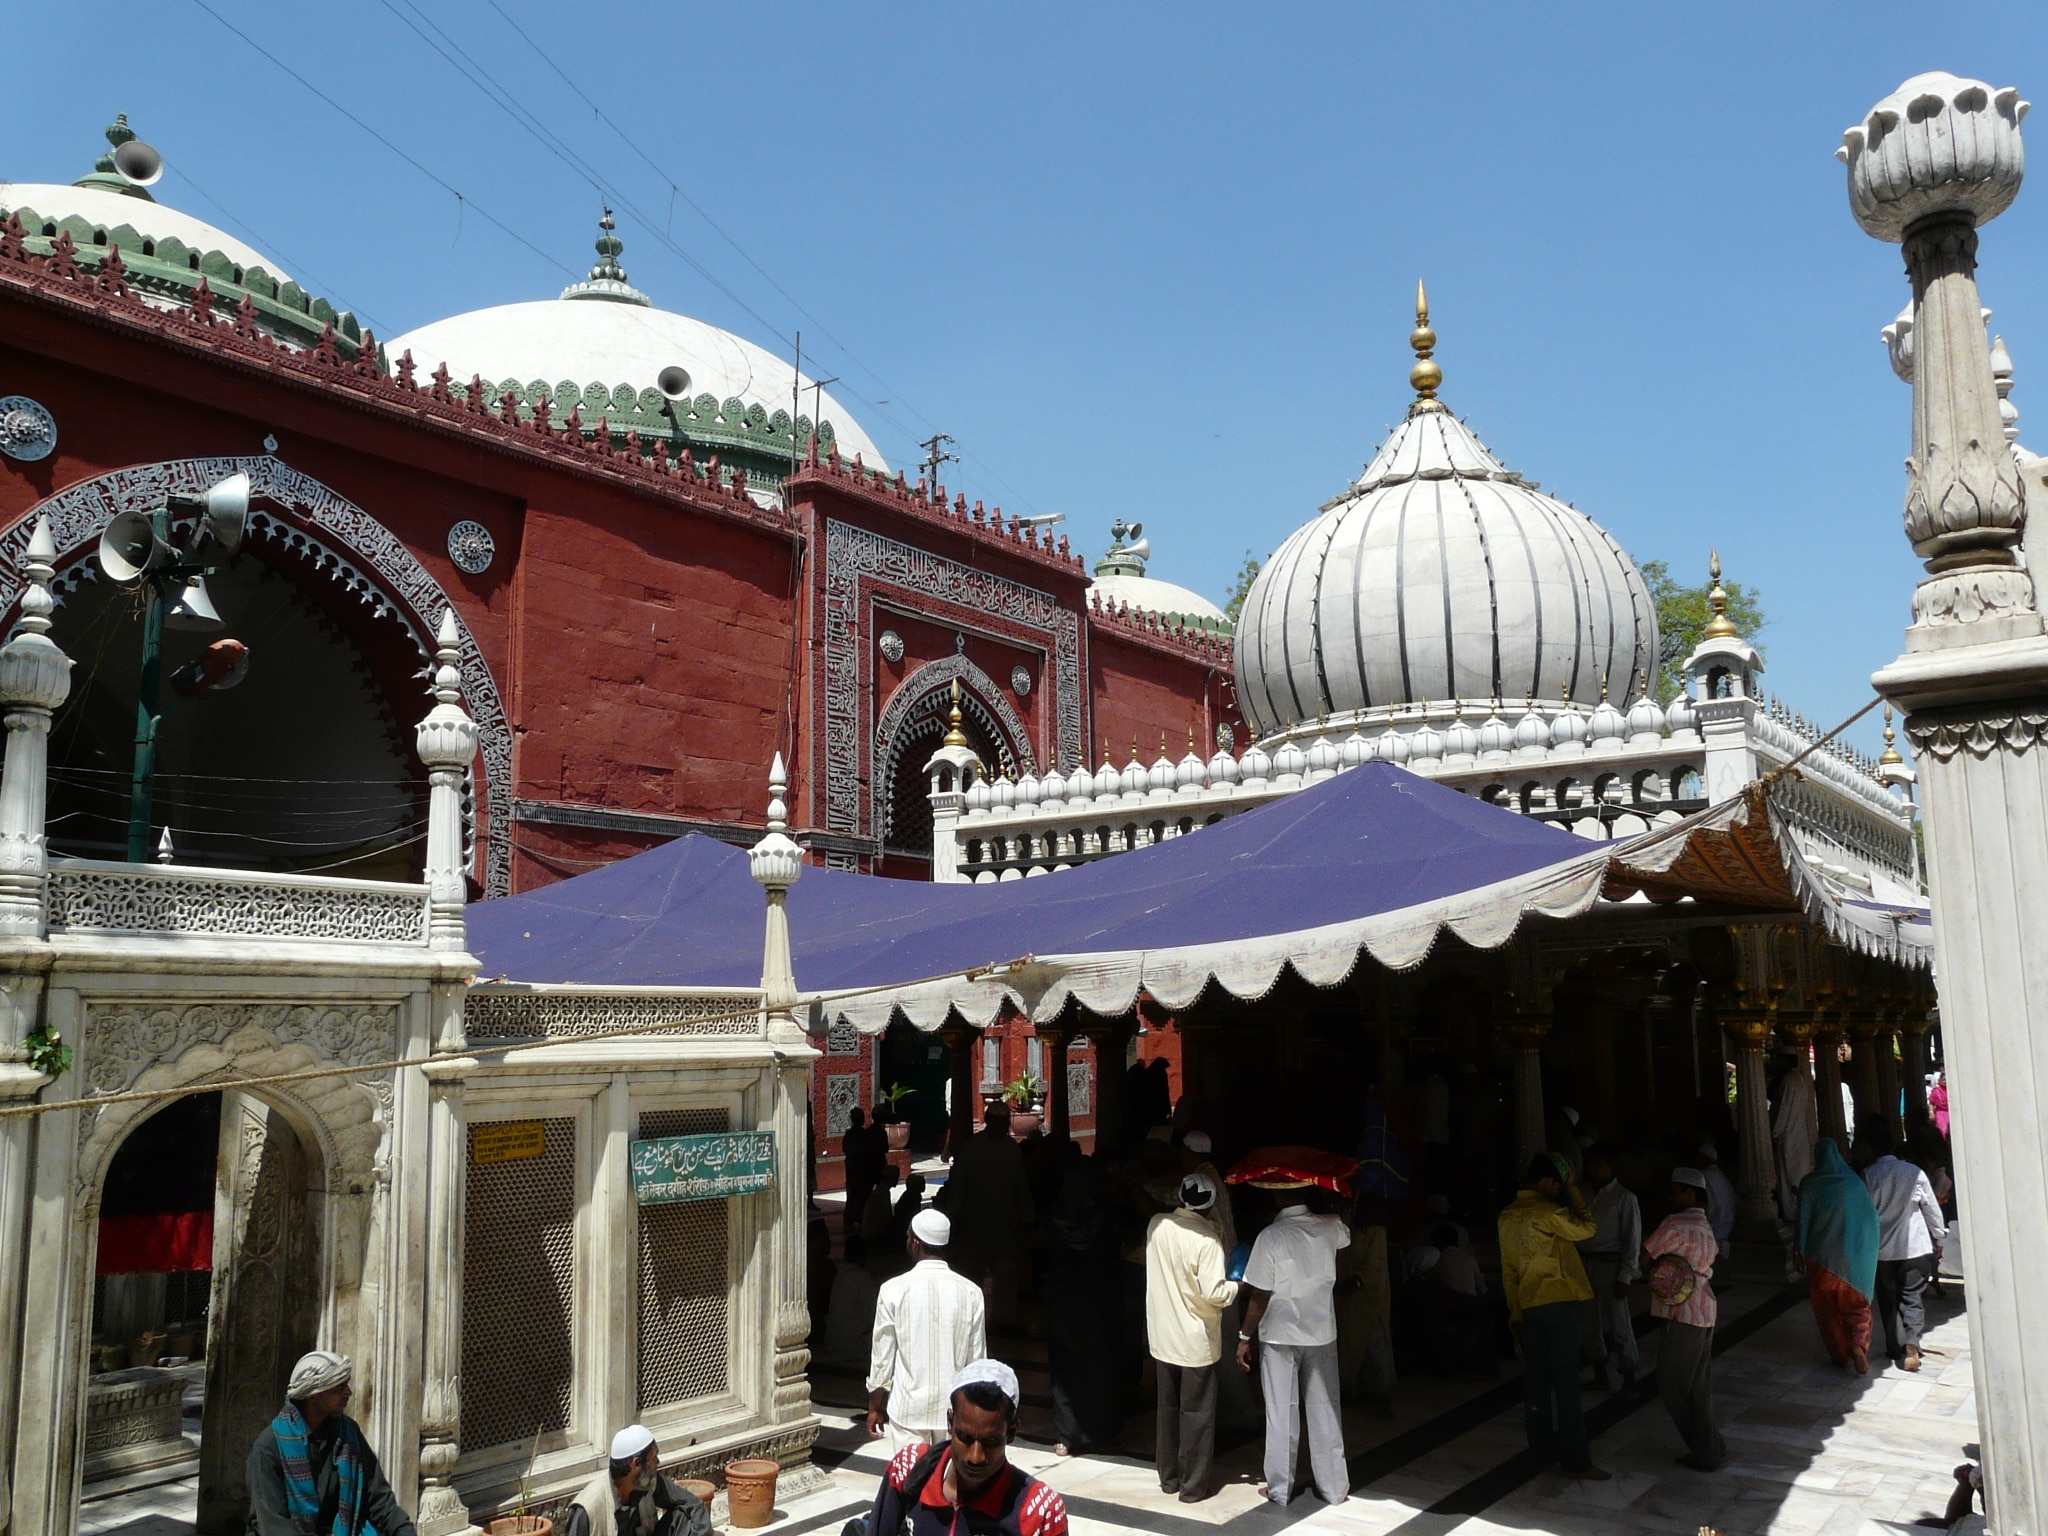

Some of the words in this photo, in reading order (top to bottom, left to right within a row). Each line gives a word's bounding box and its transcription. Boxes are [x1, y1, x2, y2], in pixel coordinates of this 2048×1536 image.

[635, 1151, 653, 1175] ہے
[643, 1146, 658, 1175] منع
[657, 1141, 681, 1168] گھومنا
[673, 1145, 697, 1175] میں
[687, 1142, 709, 1171] صحن
[704, 1138, 737, 1171] شریف
[707, 1139, 720, 1160] کے
[649, 1180, 668, 1198] लेकर
[736, 1175, 754, 1191] घूमना
[754, 1173, 767, 1186] मना
